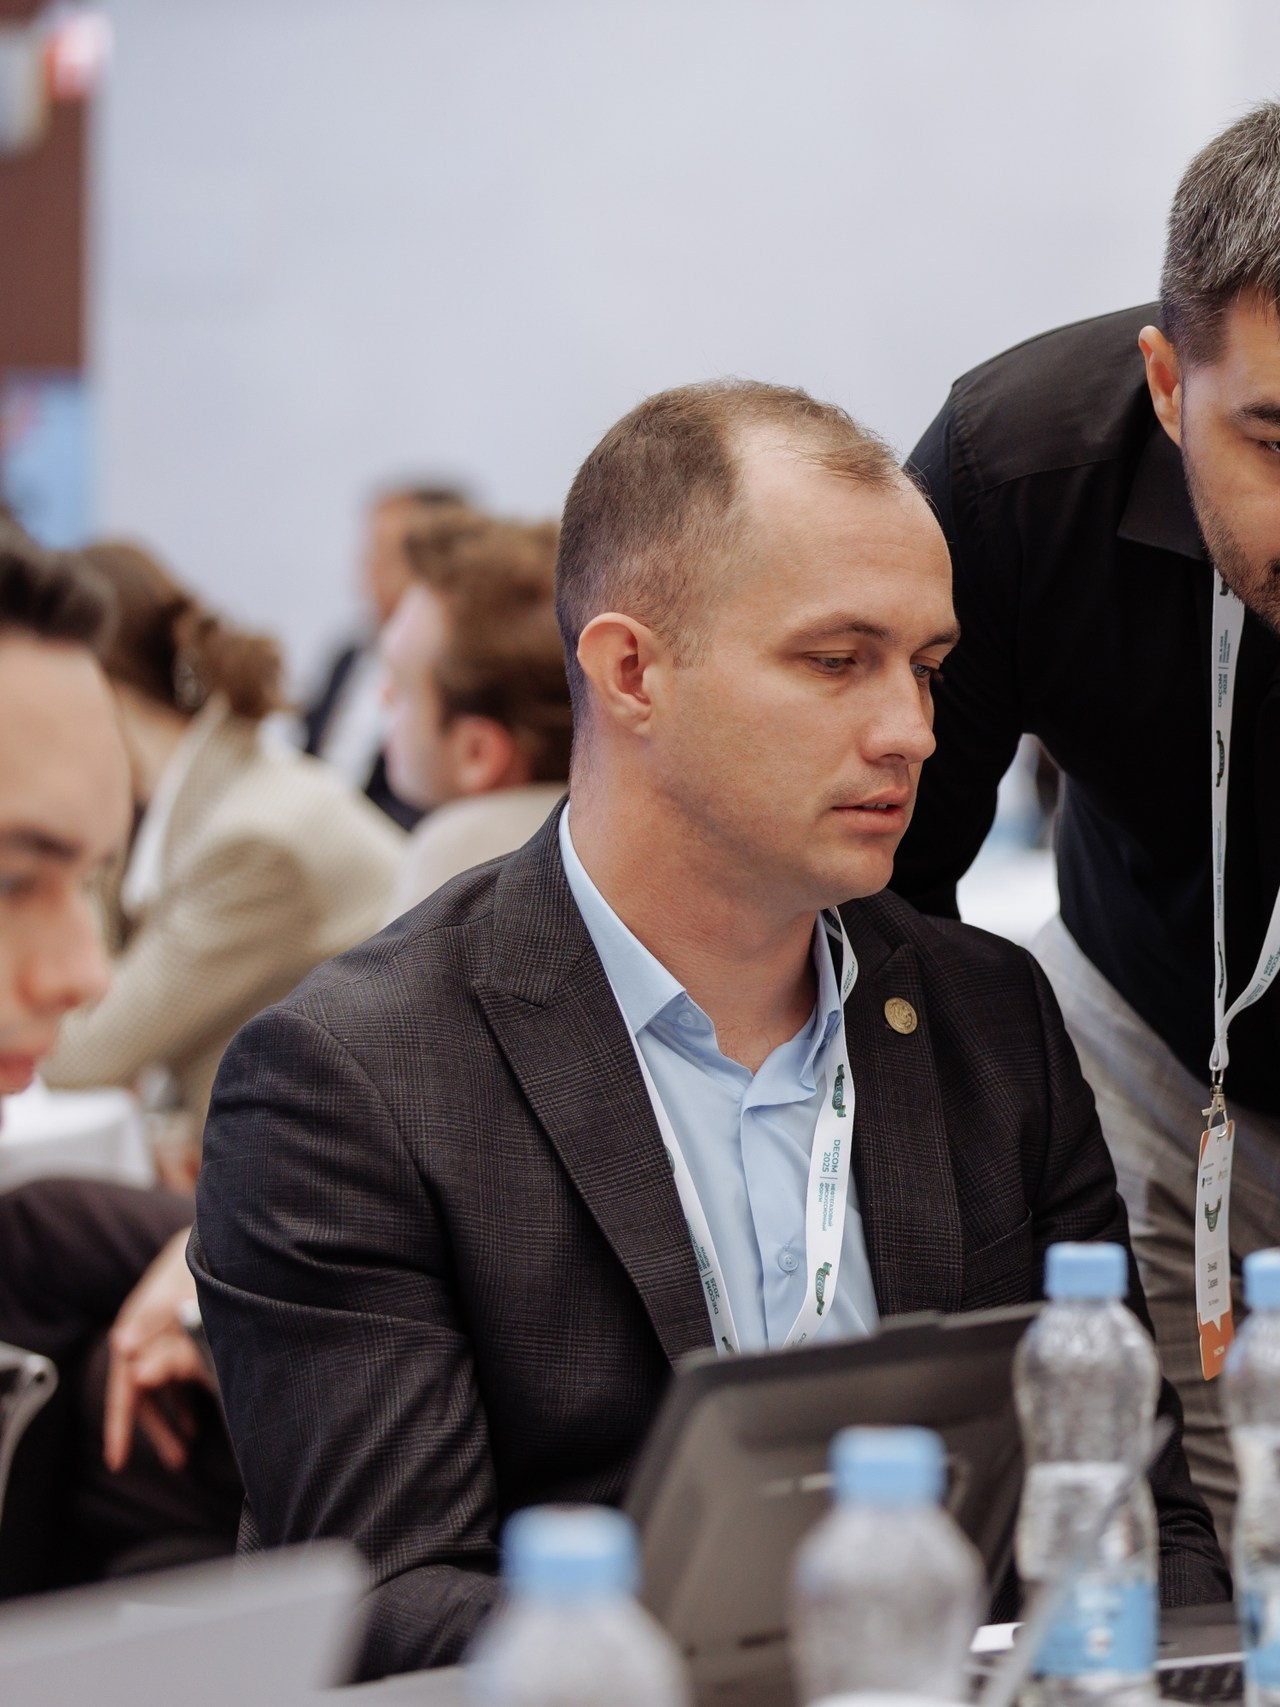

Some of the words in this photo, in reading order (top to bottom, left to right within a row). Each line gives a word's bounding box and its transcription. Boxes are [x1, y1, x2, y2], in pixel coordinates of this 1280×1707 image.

[1262, 954, 1275, 976] 2025
[821, 1152, 831, 1173] 2025
[830, 1139, 841, 1173] DECOM
[822, 1183, 830, 1232] ДИСКУССИОННЫЙ
[704, 1280, 719, 1315] DECOM
[710, 1277, 721, 1299] 2025
